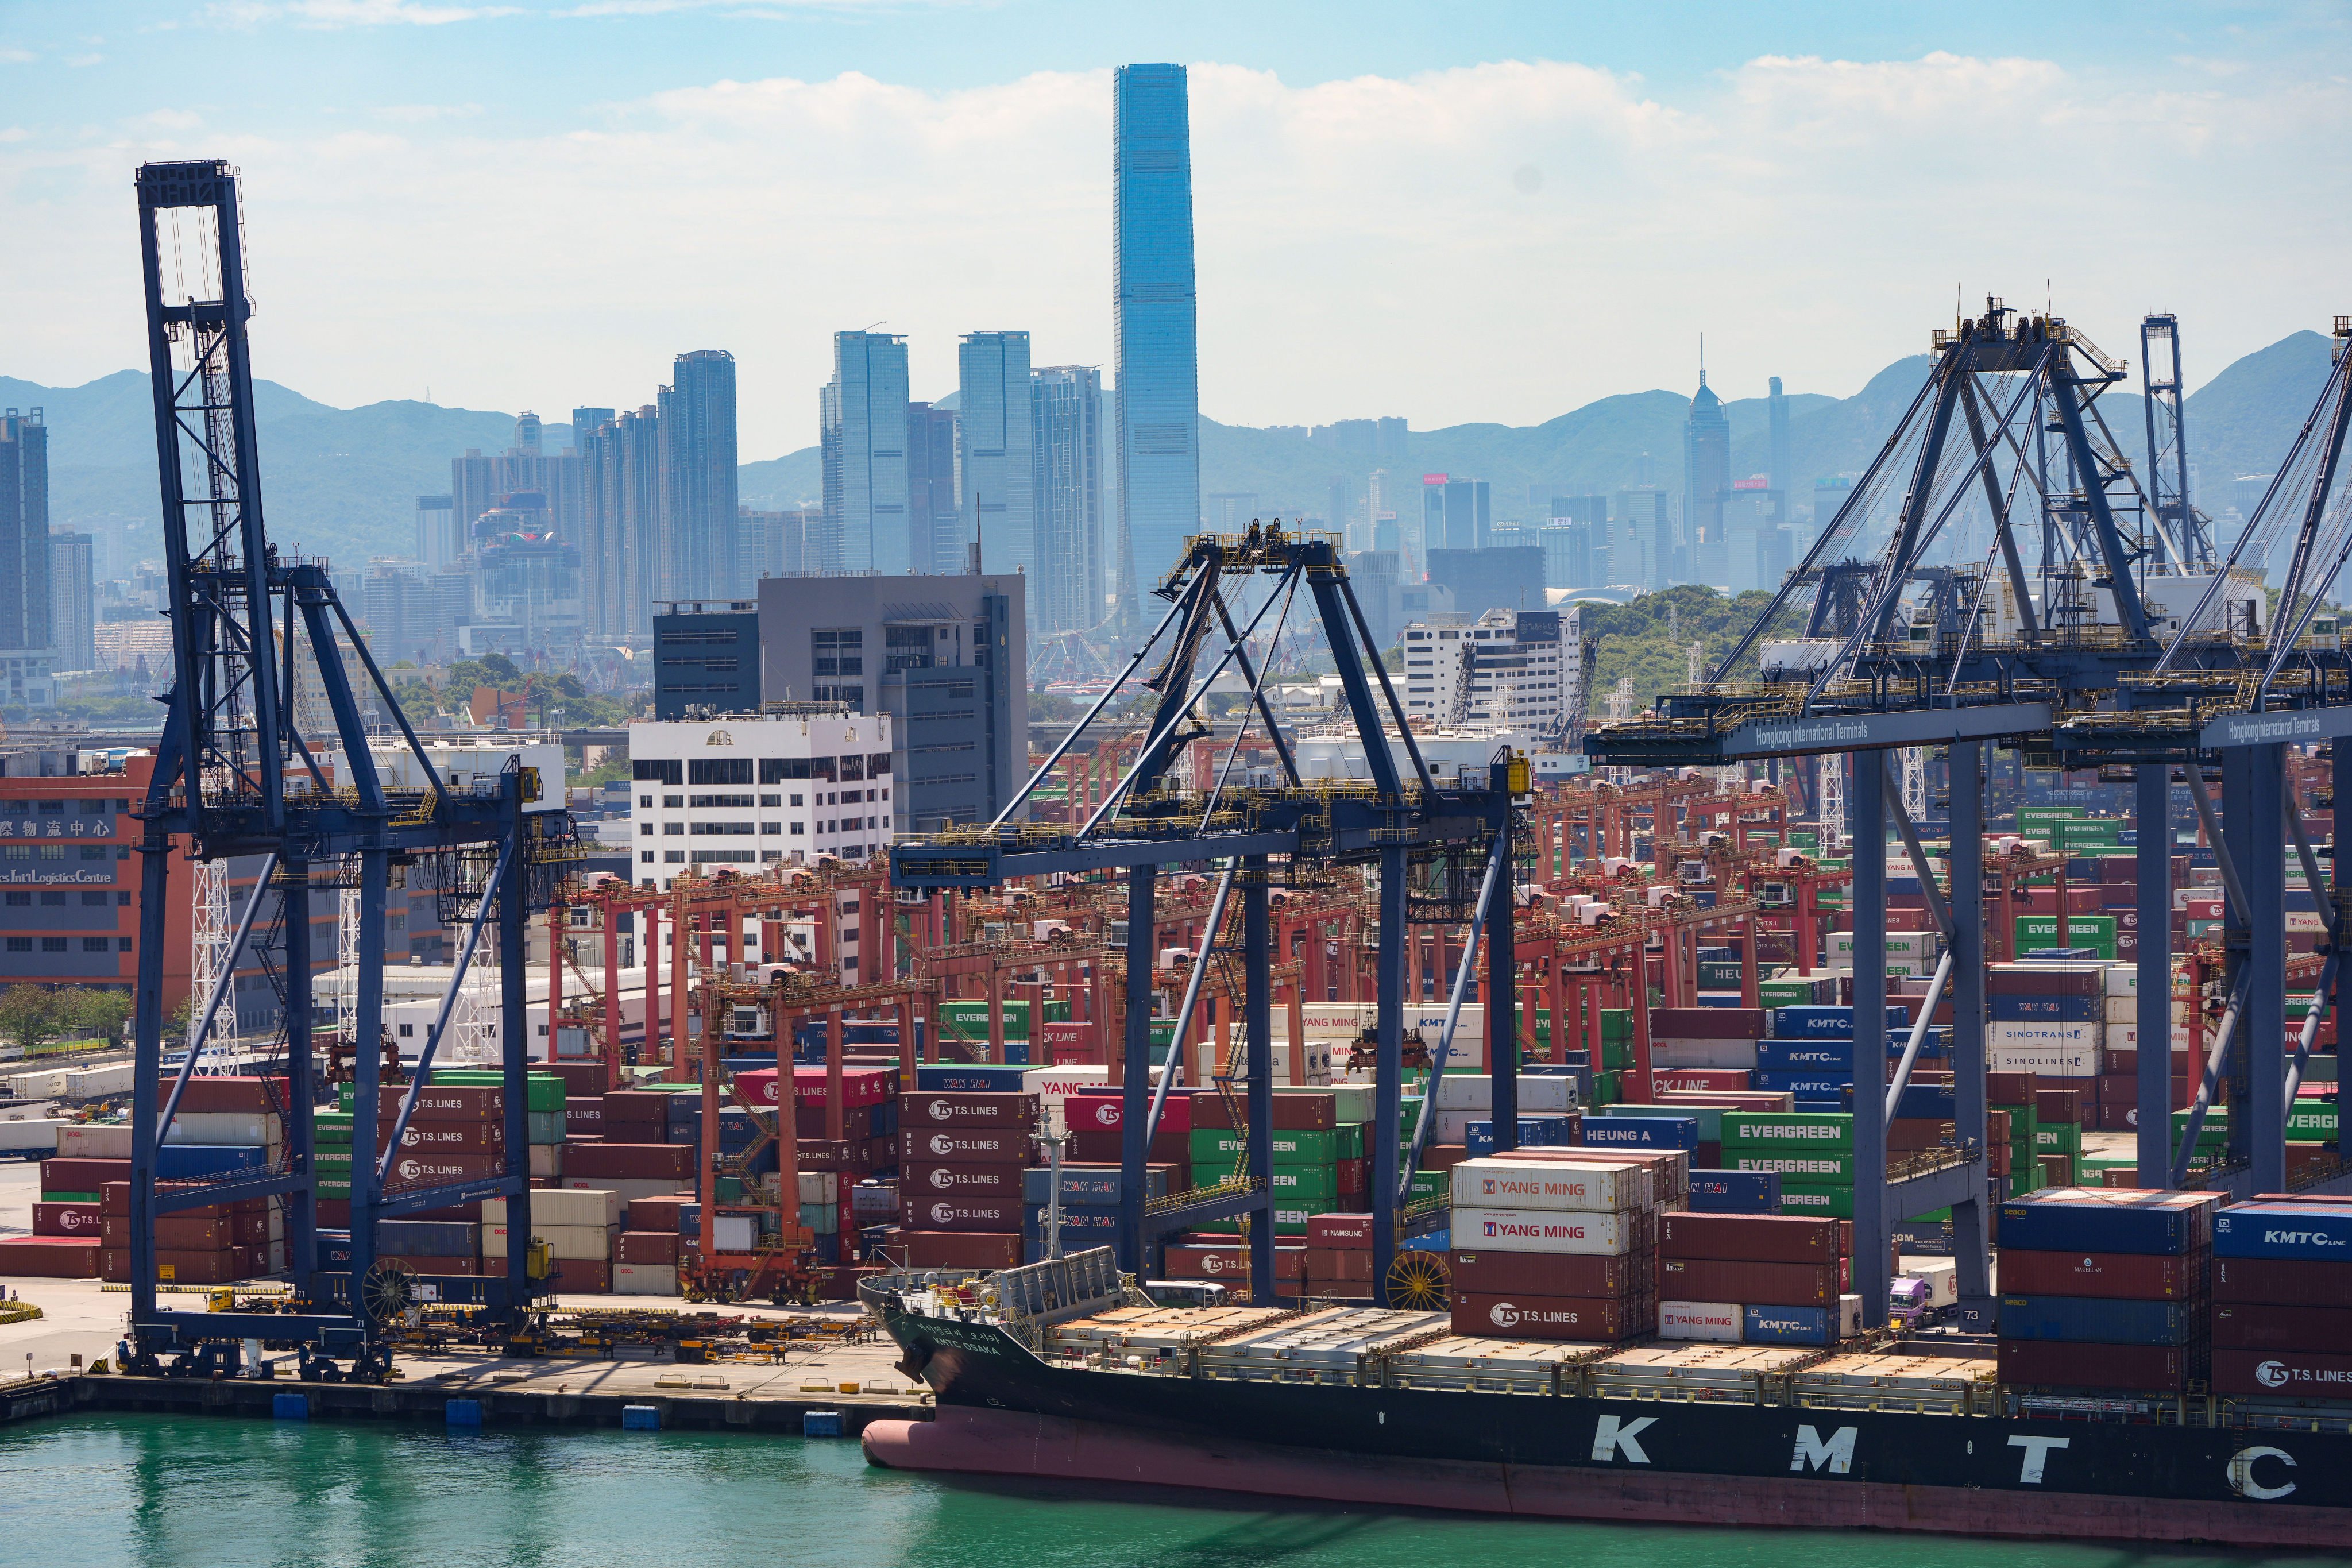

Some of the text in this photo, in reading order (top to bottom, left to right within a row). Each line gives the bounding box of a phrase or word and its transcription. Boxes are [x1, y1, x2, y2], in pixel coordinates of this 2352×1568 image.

[2229, 715, 2320, 743] Hongkong International Terminals
[1756, 721, 1867, 749] Hongkong International Terminals
[32, 870, 75, 885] Logistics
[75, 870, 111, 883] Centre
[1333, 1018, 1358, 1026] MING
[1808, 1019, 1847, 1028] KMTC
[1056, 1033, 1076, 1042] LINE
[1790, 1052, 1830, 1061] KMTC
[943, 1079, 990, 1088] WAN HAI
[1790, 1082, 1830, 1090] KMTC
[421, 1099, 462, 1108] T.S. LINES
[955, 1106, 998, 1115] T.S. LINES
[727, 1122, 744, 1130] HAI
[422, 1133, 435, 1141] T.S.
[1587, 1130, 1651, 1141] HEUNG A
[1739, 1125, 1840, 1139] EVERGREEN
[955, 1141, 998, 1149] T.S. LINES
[422, 1165, 463, 1174] T.S. LINES
[1739, 1159, 1841, 1173] EVERGREEN
[955, 1175, 999, 1184] T.S. LINES
[1064, 1181, 1114, 1192] WAN HAI
[1500, 1181, 1584, 1195] YANG MING
[1705, 1183, 1728, 1194] HAI
[956, 1209, 999, 1218] T.S. LINES
[1064, 1216, 1114, 1227] WAN HAI
[1499, 1224, 1584, 1238] YANG MING
[2264, 1231, 2328, 1245] KMTC
[1224, 1260, 1238, 1269] T.S.
[298, 1290, 305, 1298] 71
[1523, 1311, 1578, 1323] T.S. LINES
[1964, 1310, 1978, 1320] 73
[357, 1319, 365, 1327] 71
[1675, 1315, 1731, 1326] YANG MING
[1759, 1320, 1801, 1330] KMTC
[971, 1332, 1000, 1345] 오사카
[933, 1337, 1001, 1355] KMTC OSAKA
[2292, 1369, 2352, 1382] T.S. LINES
